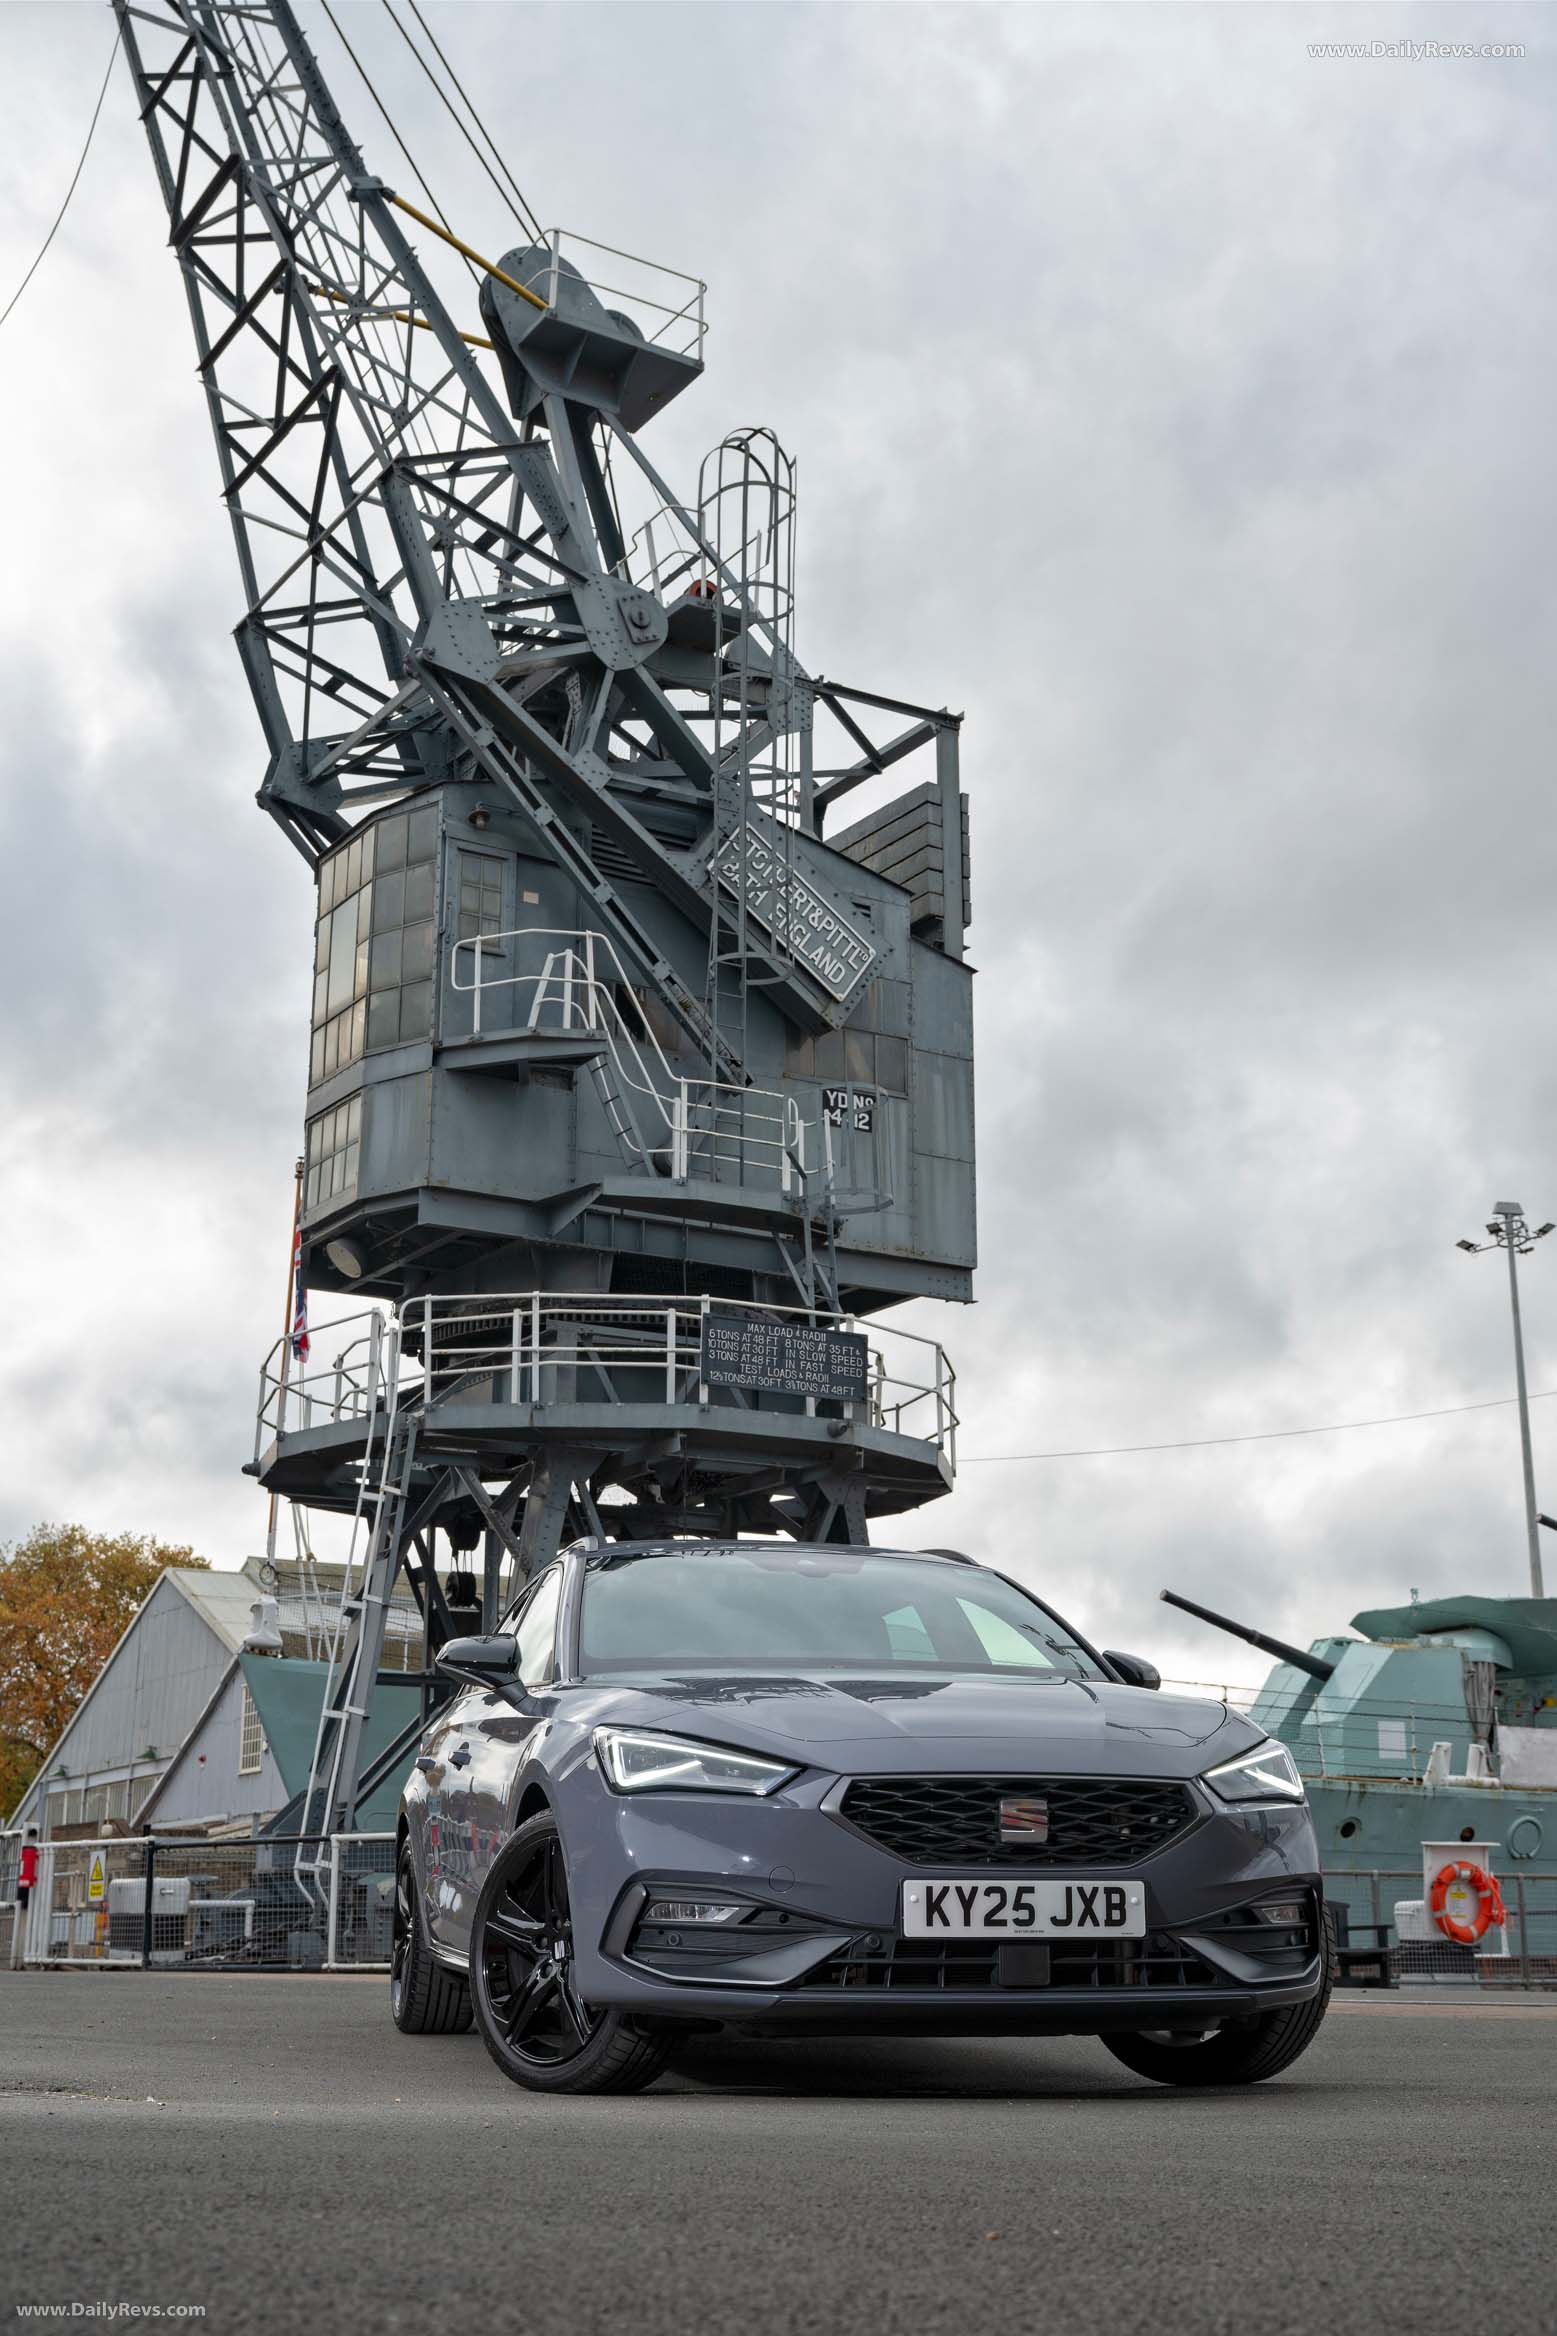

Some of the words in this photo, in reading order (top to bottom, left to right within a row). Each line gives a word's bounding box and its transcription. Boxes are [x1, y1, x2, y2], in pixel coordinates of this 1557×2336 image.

[826, 1090, 848, 1108] YD
[747, 1323, 766, 1334] MAX
[768, 1325, 793, 1338] LOAD
[802, 1330, 827, 1342] RADII
[742, 1333, 752, 1342] AT
[753, 1335, 765, 1345] 48
[766, 1336, 778, 1346] FT
[818, 1342, 827, 1352] AT
[829, 1344, 841, 1354] 35
[740, 1353, 751, 1363] AT
[752, 1355, 764, 1365] 48
[766, 1356, 777, 1366] FT
[785, 1359, 796, 1369] IN
[800, 1360, 824, 1372] FAST
[831, 1365, 863, 1378] SPEED
[741, 1343, 751, 1352] AT
[752, 1344, 765, 1355] 30
[766, 1346, 778, 1356] FT
[785, 1348, 796, 1358] IN
[799, 1350, 826, 1362] SLOW
[831, 1354, 863, 1367] SPEED
[740, 1363, 763, 1374] TEST
[767, 1367, 798, 1379] LOADS
[805, 1371, 830, 1384] RADII
[925, 1885, 1036, 1927] KY25
[1049, 1886, 1127, 1928] JXB
